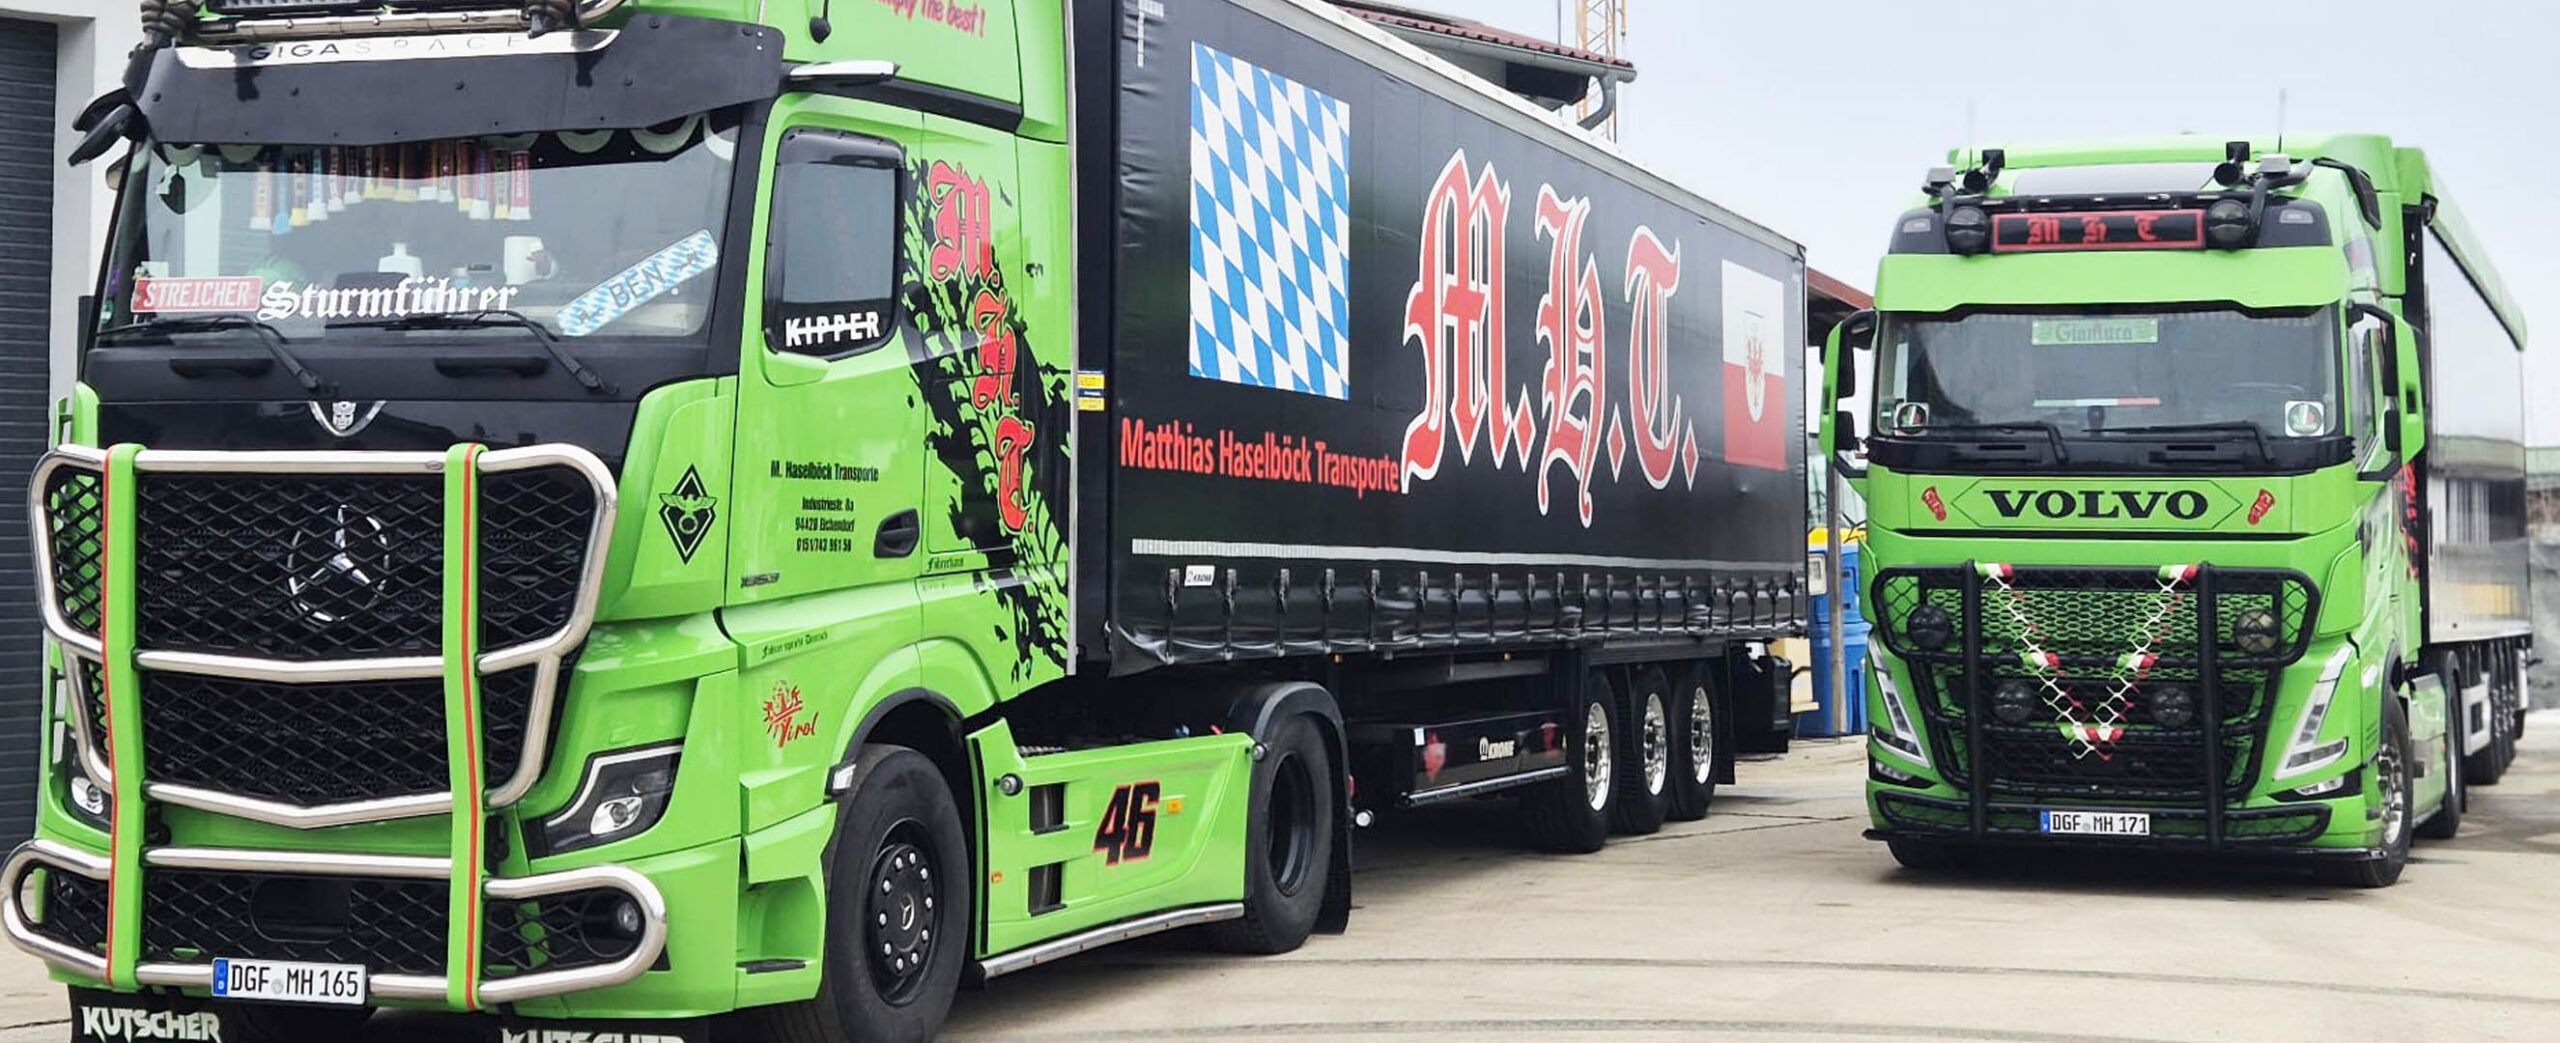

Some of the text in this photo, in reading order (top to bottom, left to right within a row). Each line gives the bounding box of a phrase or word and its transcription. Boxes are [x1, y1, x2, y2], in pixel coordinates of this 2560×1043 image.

[142, 281, 253, 309] STREICHER
[256, 276, 520, 321] Sturmführer
[609, 262, 668, 309] BEN
[785, 311, 880, 347] KIPPER
[1120, 416, 1399, 500] Matthias Haselböck Transporte
[1982, 489, 2209, 520] VOLVO
[775, 704, 819, 748] Tirol
[1093, 779, 1160, 868] 46
[2052, 814, 2148, 834] DGF MH 171
[230, 965, 271, 993] DGF
[286, 968, 314, 996] MH
[319, 970, 359, 998] 165
[81, 1006, 222, 1043] KUTSCHER
